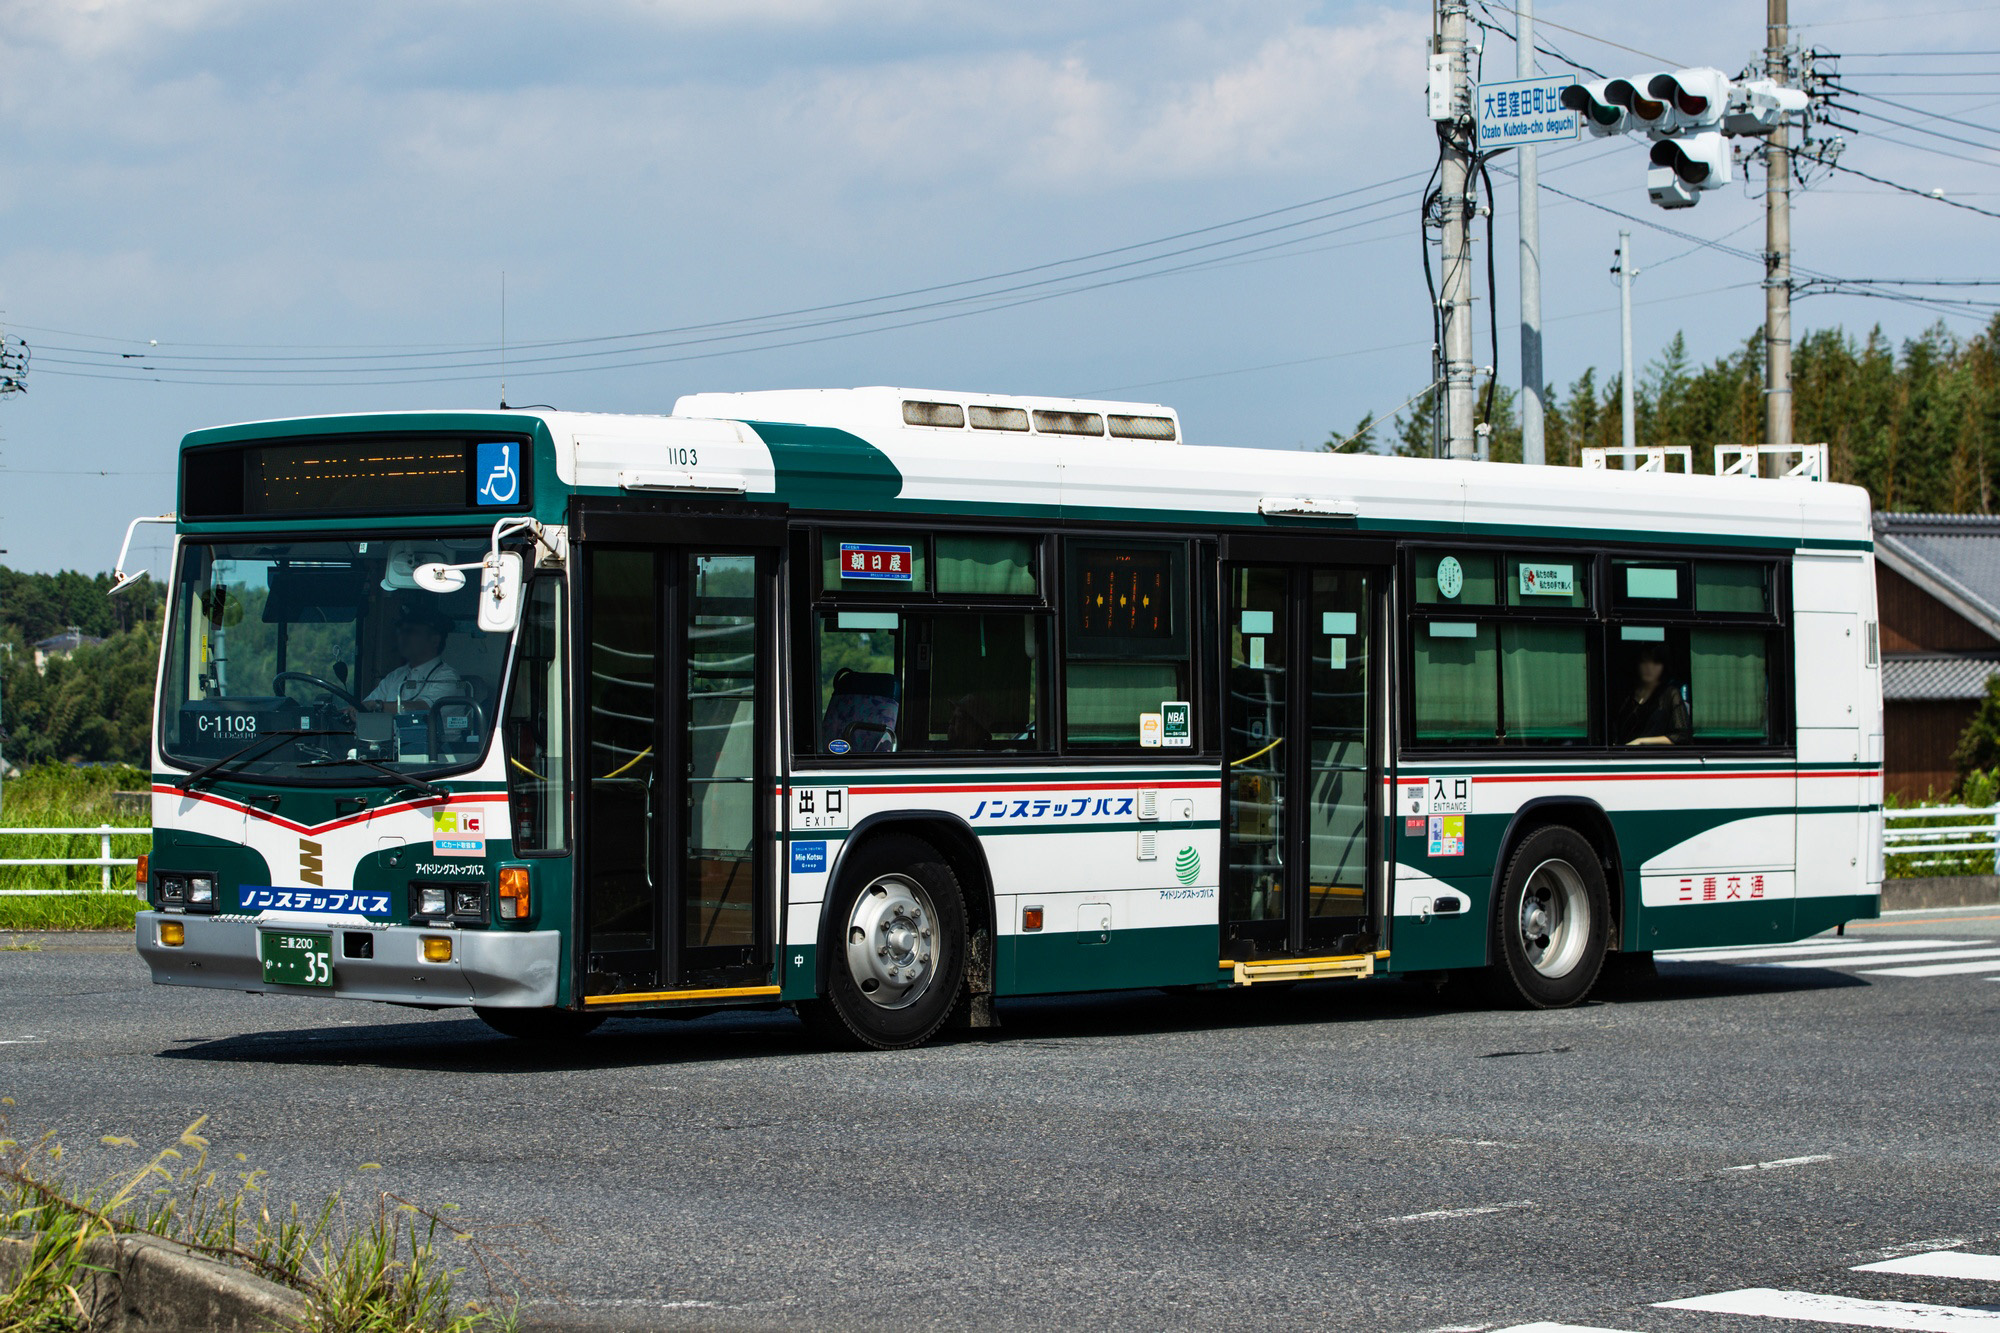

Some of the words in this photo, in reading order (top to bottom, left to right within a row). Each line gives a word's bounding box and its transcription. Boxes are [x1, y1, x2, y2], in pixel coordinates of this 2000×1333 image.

[1482, 124, 1501, 139] Ozato
[1503, 121, 1543, 136] Kubota-cho
[1546, 116, 1574, 134] deguchi
[668, 447, 698, 466] 1103
[851, 552, 902, 571] 朝日屋
[198, 715, 256, 732] C-1103
[1167, 712, 1185, 722] NBA
[1434, 779, 1467, 800] 入口
[799, 789, 842, 814] 出口
[969, 797, 1134, 820] ノンステップバス
[1433, 802, 1467, 812] ENTRANCE
[805, 816, 835, 827] EXIT
[795, 853, 806, 861] Mie
[807, 853, 824, 861] Kotsu
[415, 863, 485, 876] アイドリングストップバス
[1159, 889, 1215, 900] アイドリングストップバス
[1679, 875, 1764, 901] 三重交通
[241, 890, 389, 912] ノンステップバス
[794, 954, 804, 968] 中
